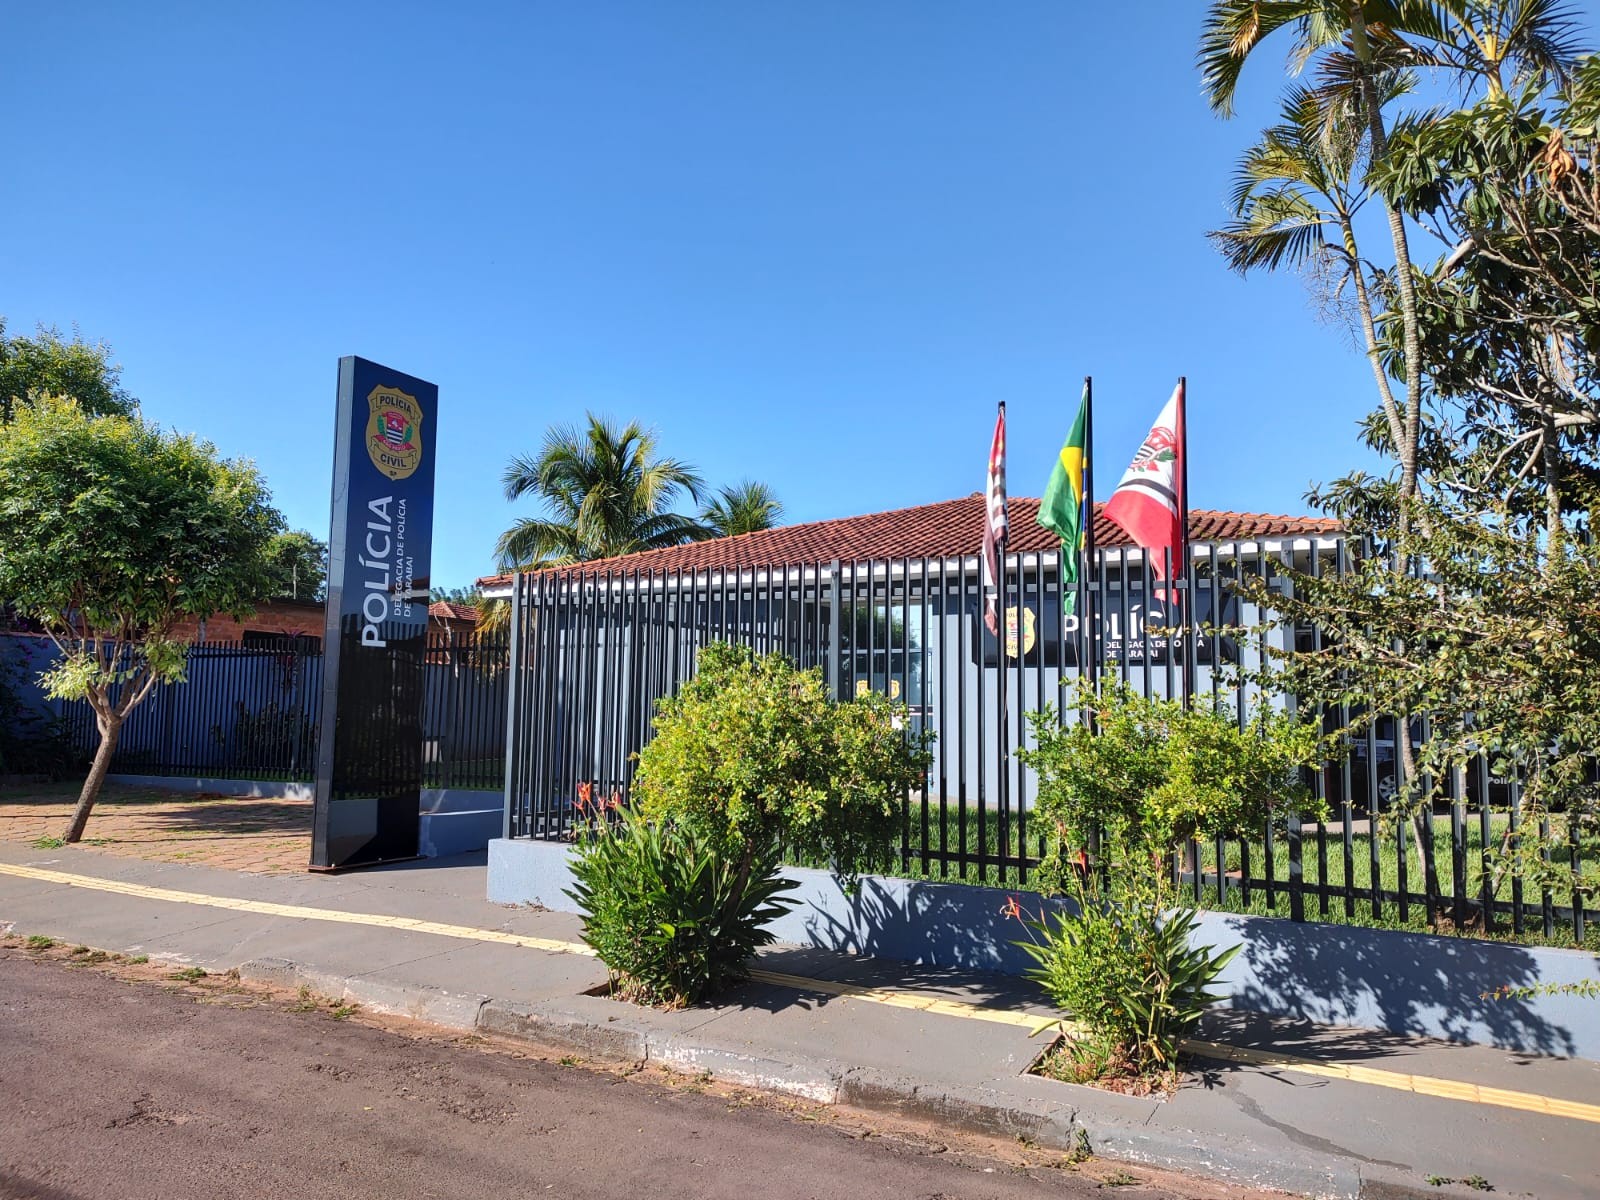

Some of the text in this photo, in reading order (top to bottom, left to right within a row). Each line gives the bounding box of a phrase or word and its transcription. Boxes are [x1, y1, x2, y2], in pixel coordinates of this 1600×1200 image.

[380, 453, 407, 468] CIVIL
[358, 496, 393, 648] POLÍCIA
[394, 498, 407, 616] DELEGACIA DE POLÍCIA
[404, 556, 413, 617] DE TARABAI
[1155, 640, 1167, 648] DE
